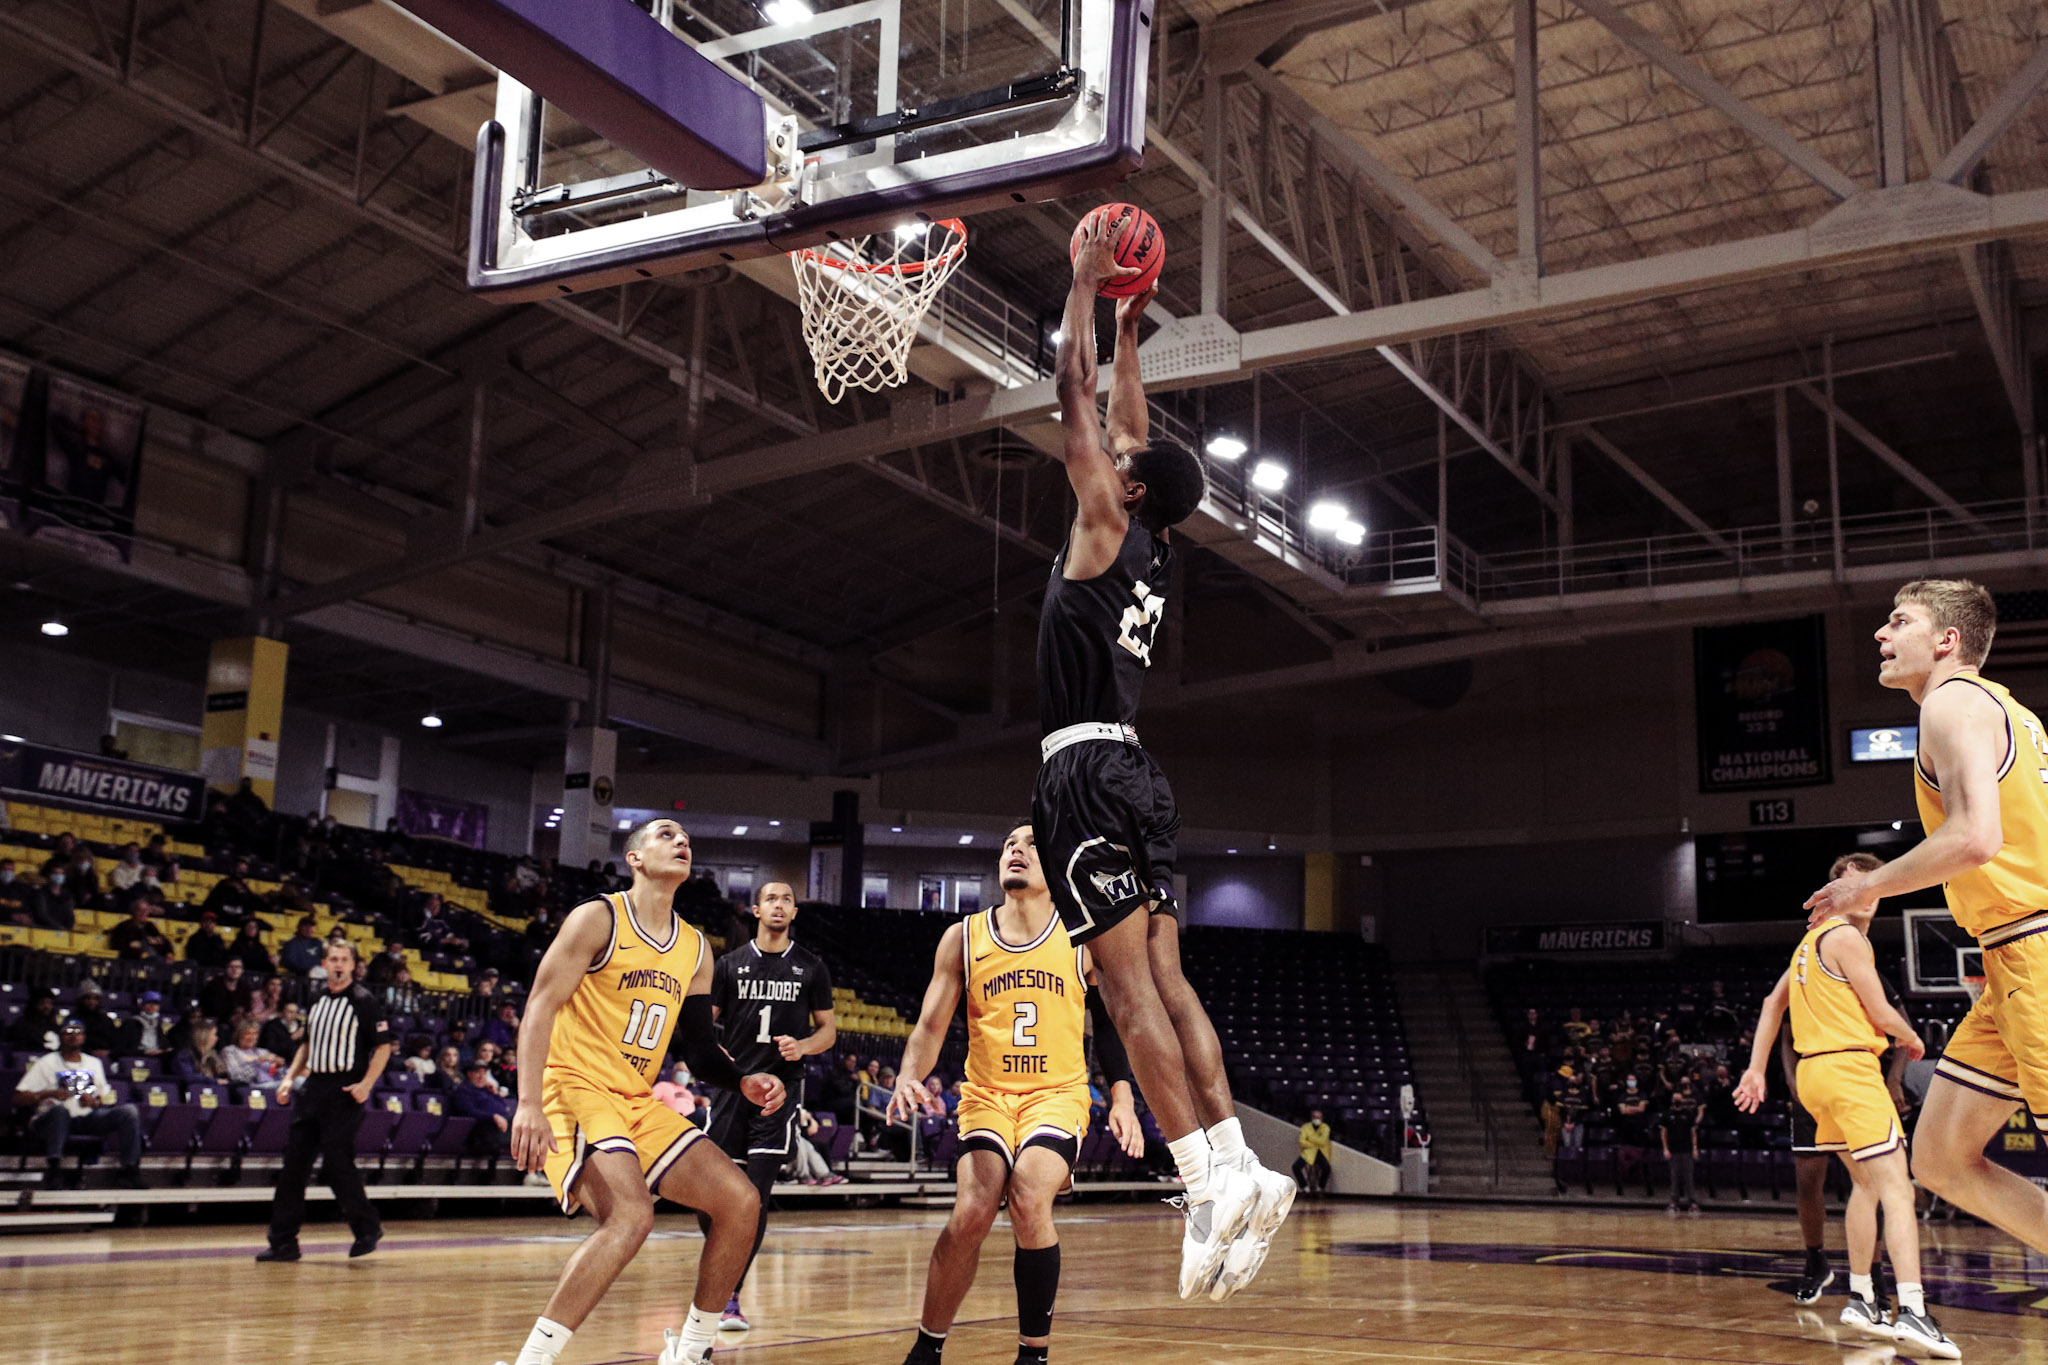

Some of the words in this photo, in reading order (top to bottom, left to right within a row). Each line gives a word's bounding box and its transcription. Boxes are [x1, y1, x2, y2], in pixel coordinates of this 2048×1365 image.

[1133, 222, 1155, 264] NCAA
[1711, 760, 1818, 782] CHAMPIONS
[1718, 747, 1809, 766] NATIONAL
[37, 761, 192, 813] MAVERICKS
[1755, 801, 1789, 823] 113
[1538, 929, 1652, 949] MAVERICKS
[617, 969, 681, 1004] MINNESOTA
[737, 979, 802, 1002] WALDORF
[983, 969, 1064, 1001] MINNESOTA
[622, 998, 667, 1050] 10
[756, 1004, 772, 1044] 1
[1013, 1001, 1037, 1047] 2
[1003, 1055, 1048, 1073] STATE
